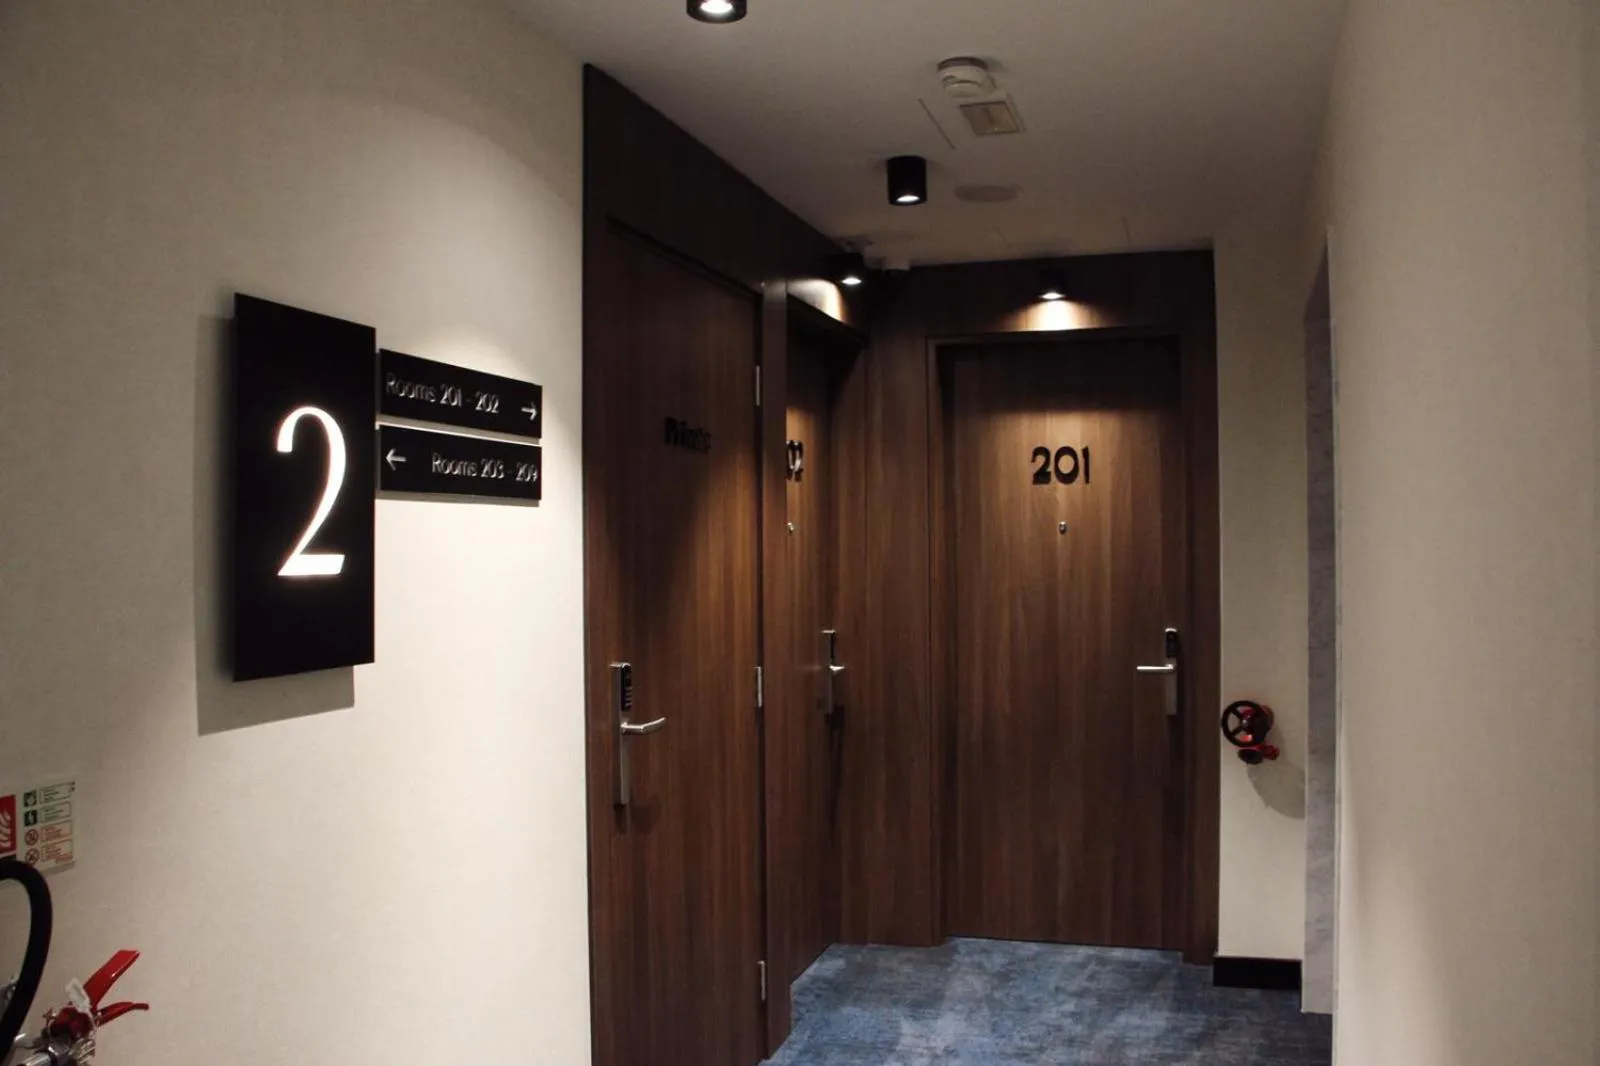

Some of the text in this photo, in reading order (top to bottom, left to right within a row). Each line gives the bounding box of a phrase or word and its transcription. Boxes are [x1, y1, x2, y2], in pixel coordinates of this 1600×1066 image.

[386, 372, 436, 402] Rooms
[440, 383, 462, 407] 201
[475, 391, 499, 413] 202
[432, 452, 477, 477] Rooms
[481, 458, 504, 479] 203
[785, 440, 804, 481] 02
[1031, 446, 1090, 485] 201
[277, 406, 346, 576] 2
